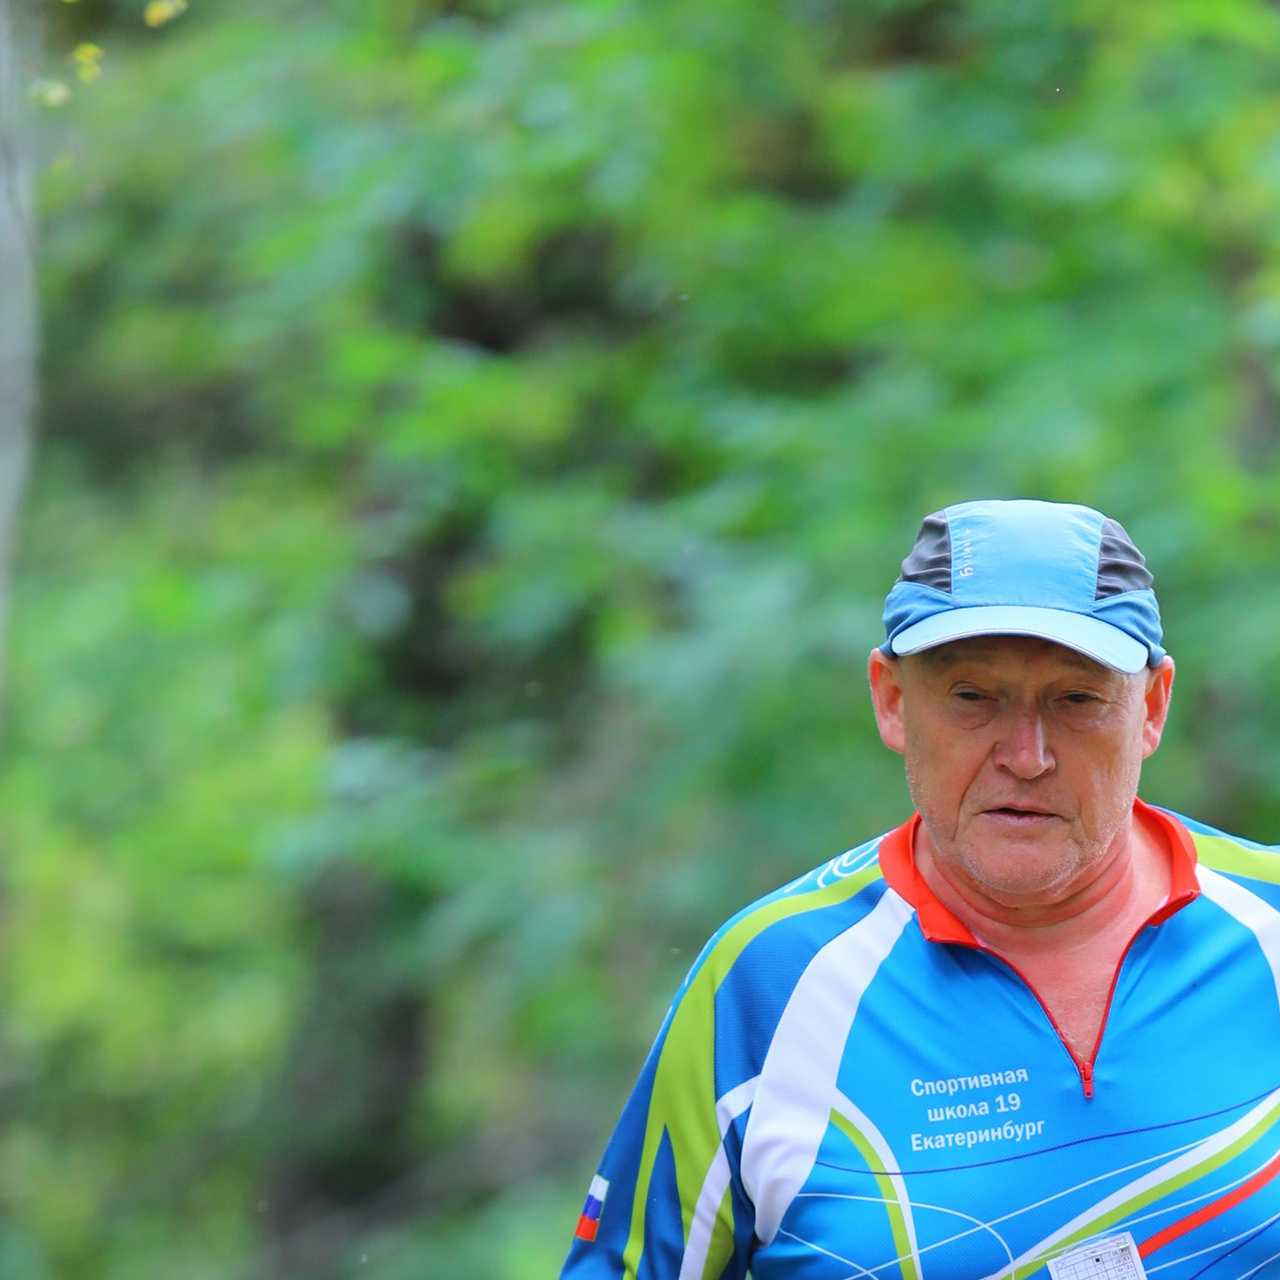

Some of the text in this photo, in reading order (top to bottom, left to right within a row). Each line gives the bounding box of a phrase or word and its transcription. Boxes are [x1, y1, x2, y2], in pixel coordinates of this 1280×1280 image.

[910, 1067, 1029, 1097] Спортивная
[927, 1092, 1022, 1122] школа 19
[910, 1119, 1046, 1152] Екатеринбург
